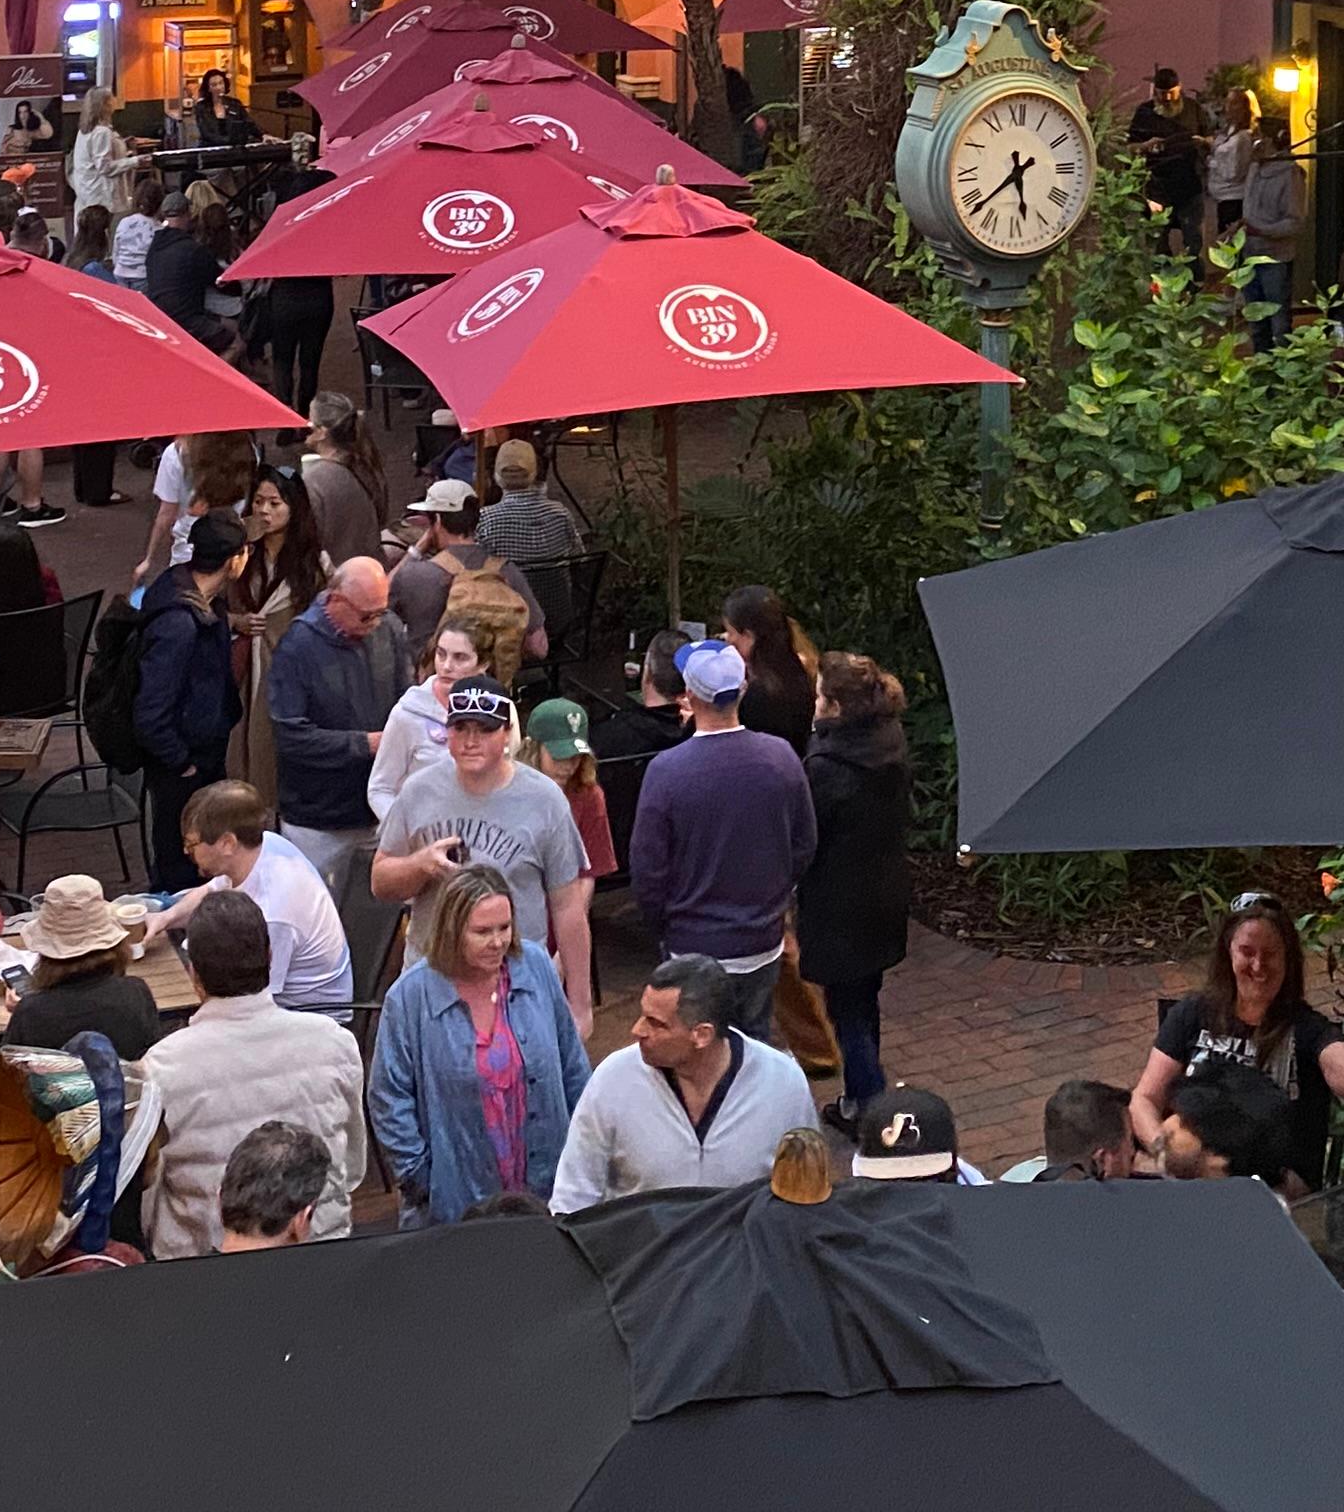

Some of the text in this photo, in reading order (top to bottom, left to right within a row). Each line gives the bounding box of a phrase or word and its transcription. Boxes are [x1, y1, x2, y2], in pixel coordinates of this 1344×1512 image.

[449, 207, 493, 220] BIN
[449, 220, 487, 236] 39
[686, 305, 737, 324] BIN
[700, 322, 738, 345] 39
